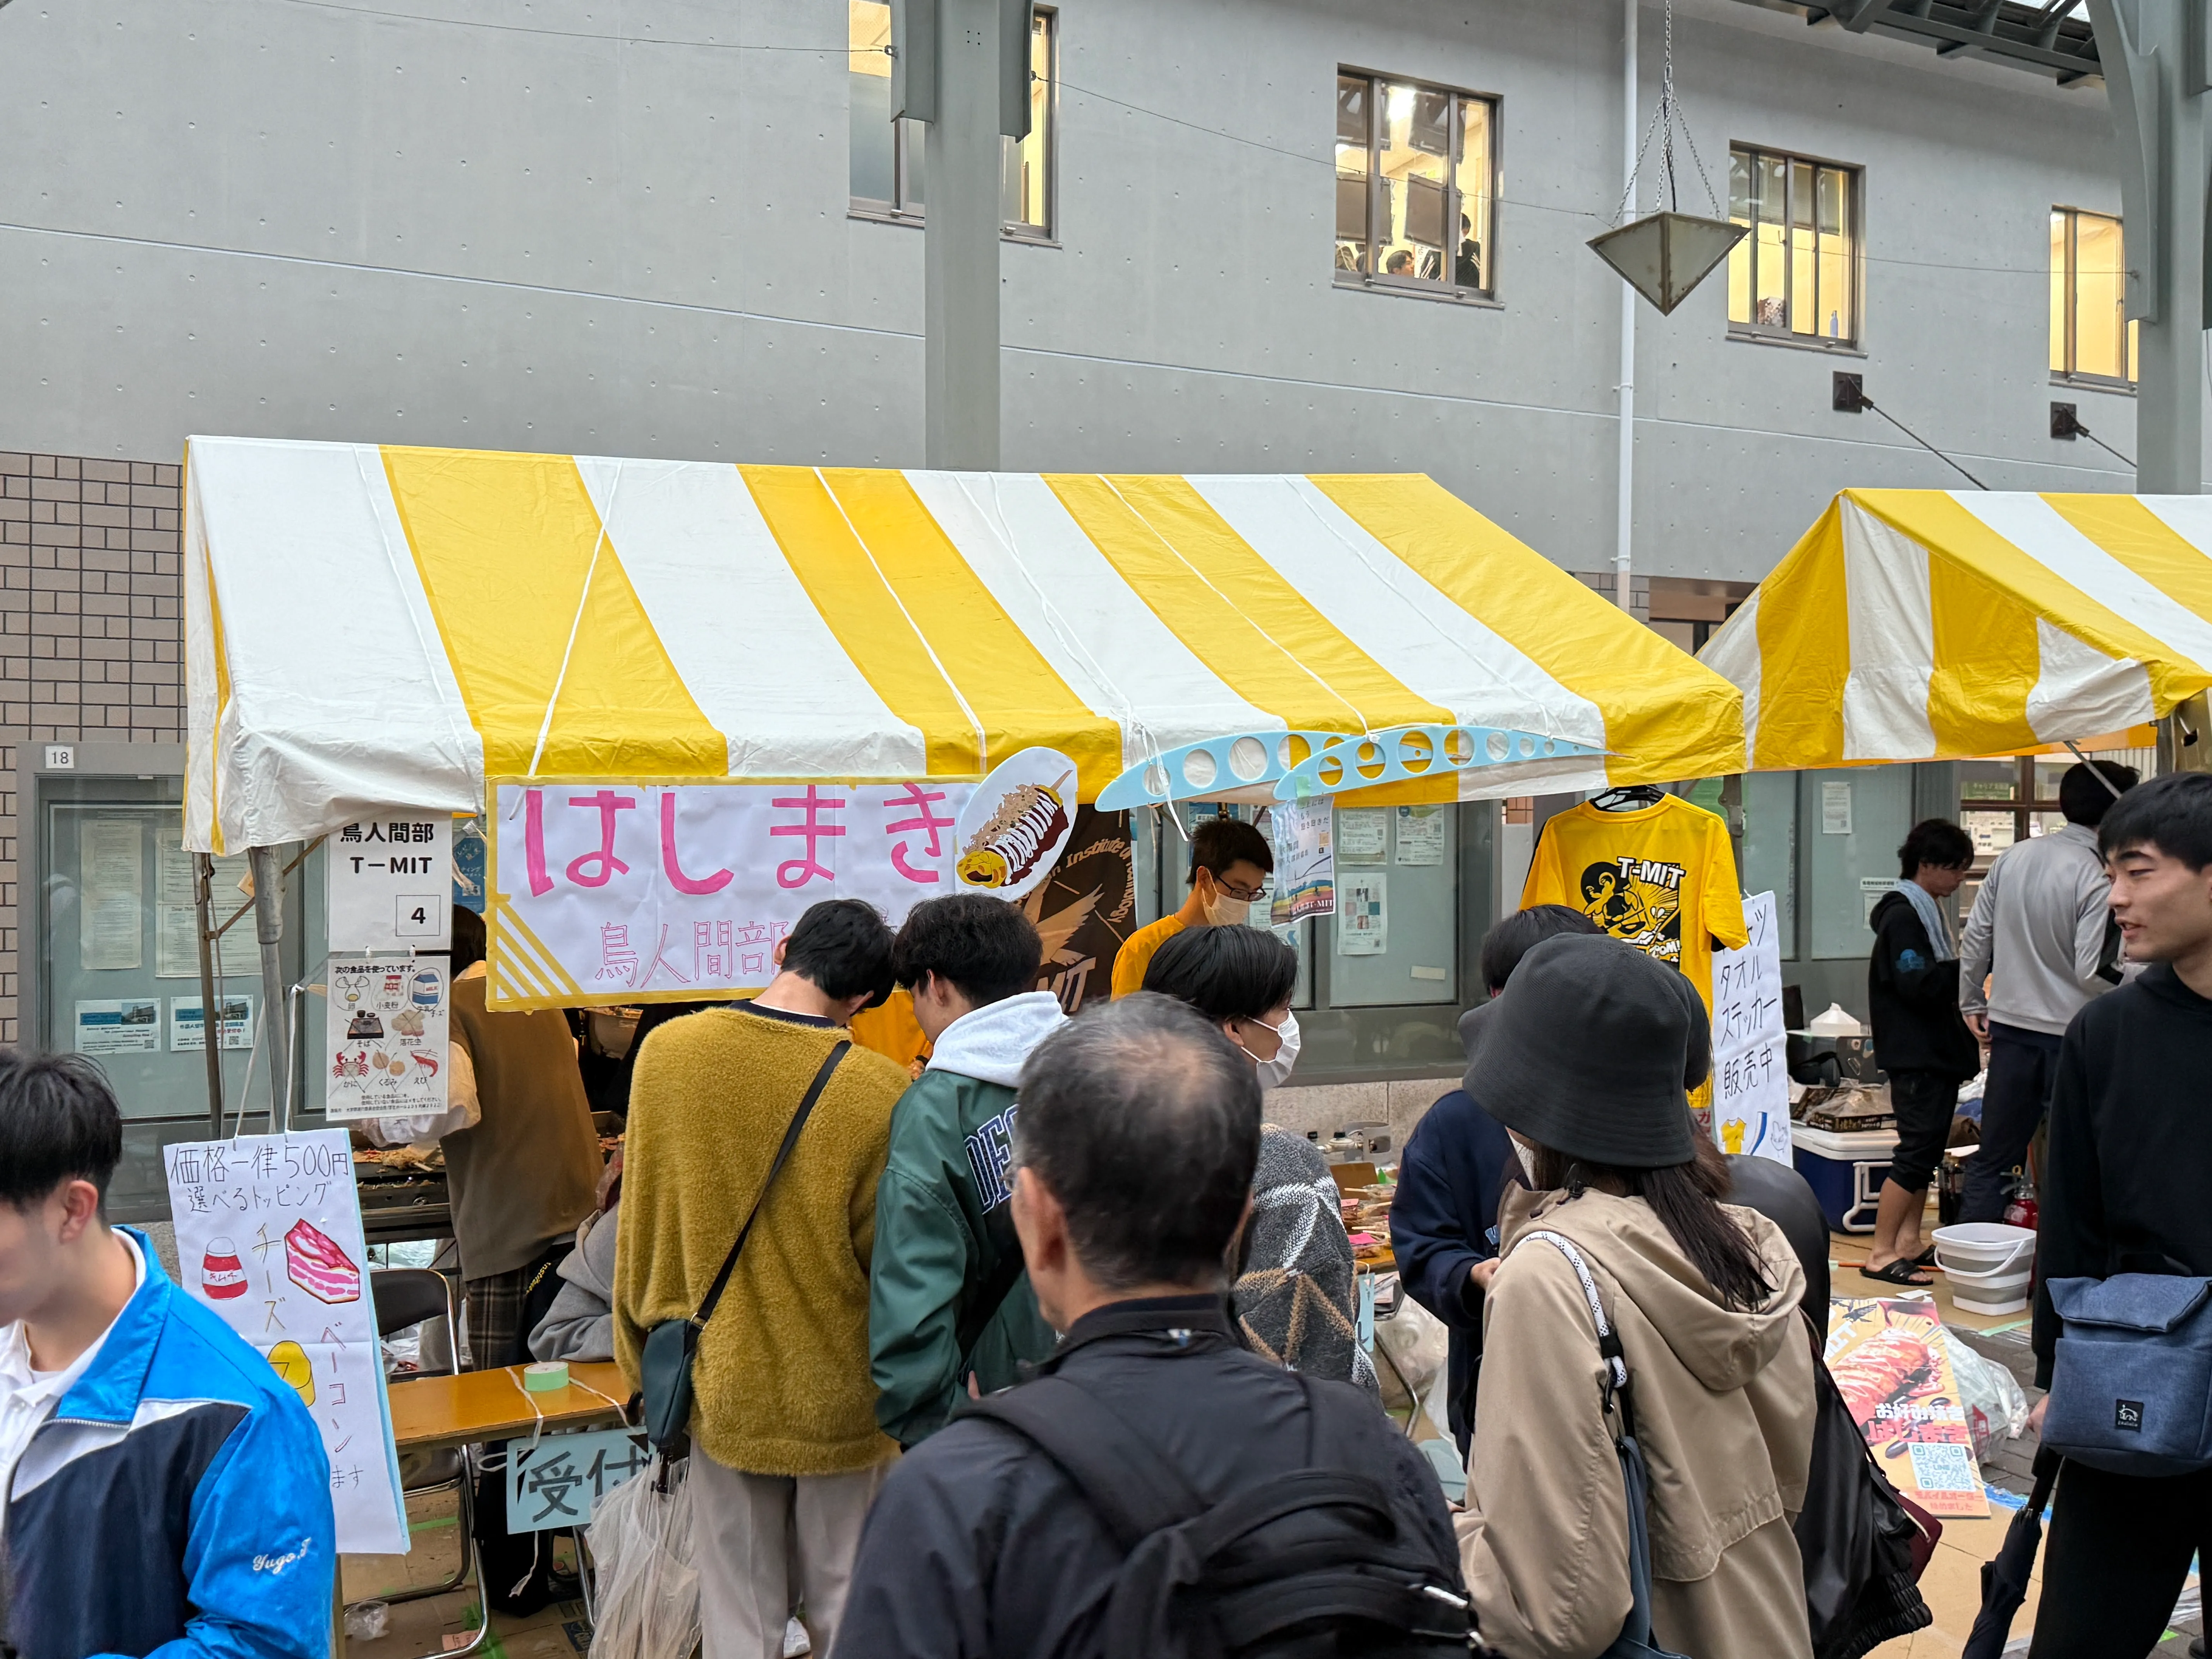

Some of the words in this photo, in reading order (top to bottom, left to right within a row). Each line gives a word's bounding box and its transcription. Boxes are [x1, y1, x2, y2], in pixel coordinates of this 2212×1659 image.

[51, 751, 69, 764] 18
[1300, 799, 1324, 809] 上には
[340, 823, 434, 843] 鳥人間部
[525, 782, 955, 897] はしまき
[350, 857, 433, 874] T-MIT
[1065, 837, 1126, 868] Institute
[1617, 857, 1686, 889] T-MIT
[411, 907, 426, 924] 4
[595, 919, 788, 988] 鳥人間部
[1721, 955, 1762, 1001] タオル
[1720, 990, 1777, 1047] ステッカー
[1724, 1042, 1772, 1100] 販売中
[170, 1144, 349, 1185] 価格一律500円
[188, 1181, 332, 1213] 選べるトッピング
[252, 1222, 286, 1333] チーズ
[320, 1321, 352, 1453] ベーコン
[1875, 1403, 1965, 1421] お好み焼き
[1866, 1419, 1970, 1444] はしまき
[331, 1464, 364, 1489] ます
[529, 1444, 644, 1523] 受付
